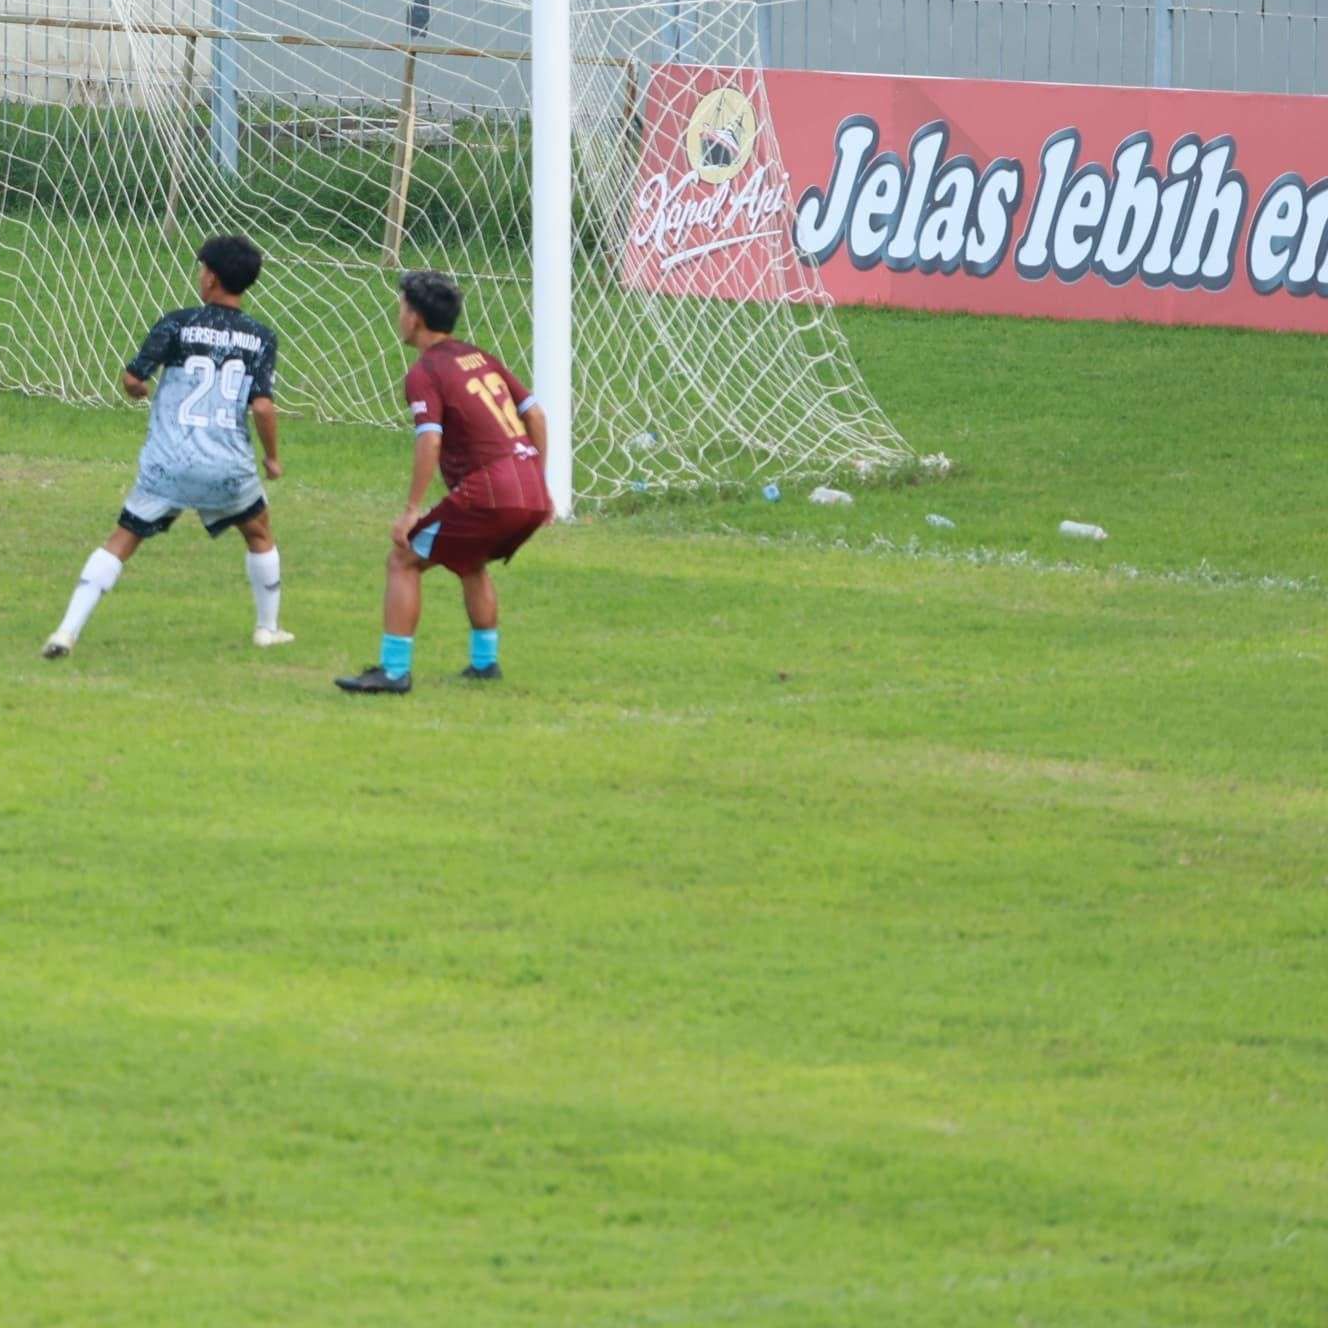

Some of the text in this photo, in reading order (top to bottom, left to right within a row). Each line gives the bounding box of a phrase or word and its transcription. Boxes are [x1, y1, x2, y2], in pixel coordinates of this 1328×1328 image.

[793, 114, 1022, 277] Jelas
[1014, 127, 1246, 292] lebih
[177, 355, 254, 430] 29
